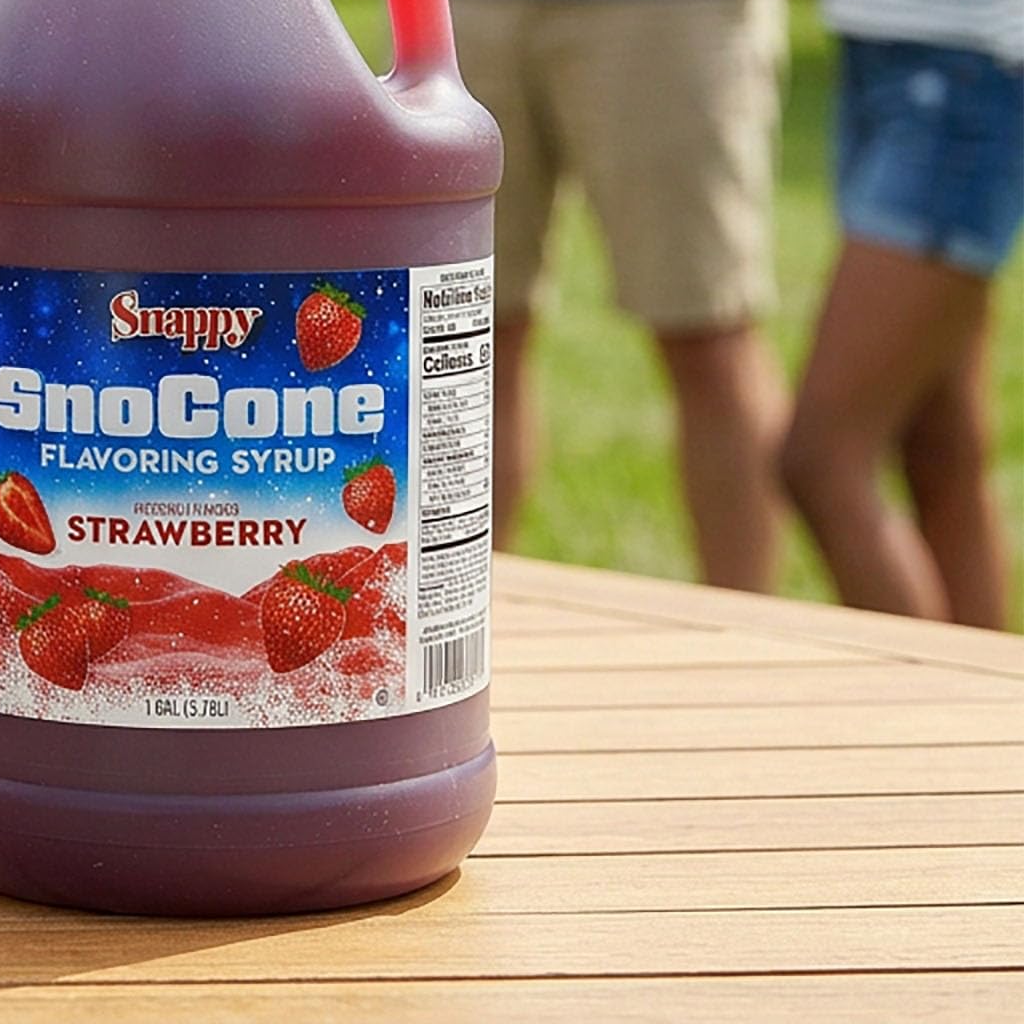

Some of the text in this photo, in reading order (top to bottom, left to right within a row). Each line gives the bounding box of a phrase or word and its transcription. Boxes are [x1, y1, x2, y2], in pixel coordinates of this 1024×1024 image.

[110, 290, 263, 351] Snappy
[40, 443, 337, 475] FLAVORING SYRUP
[67, 515, 307, 547] STRAWBERRY
[155, 699, 181, 716] GAL
